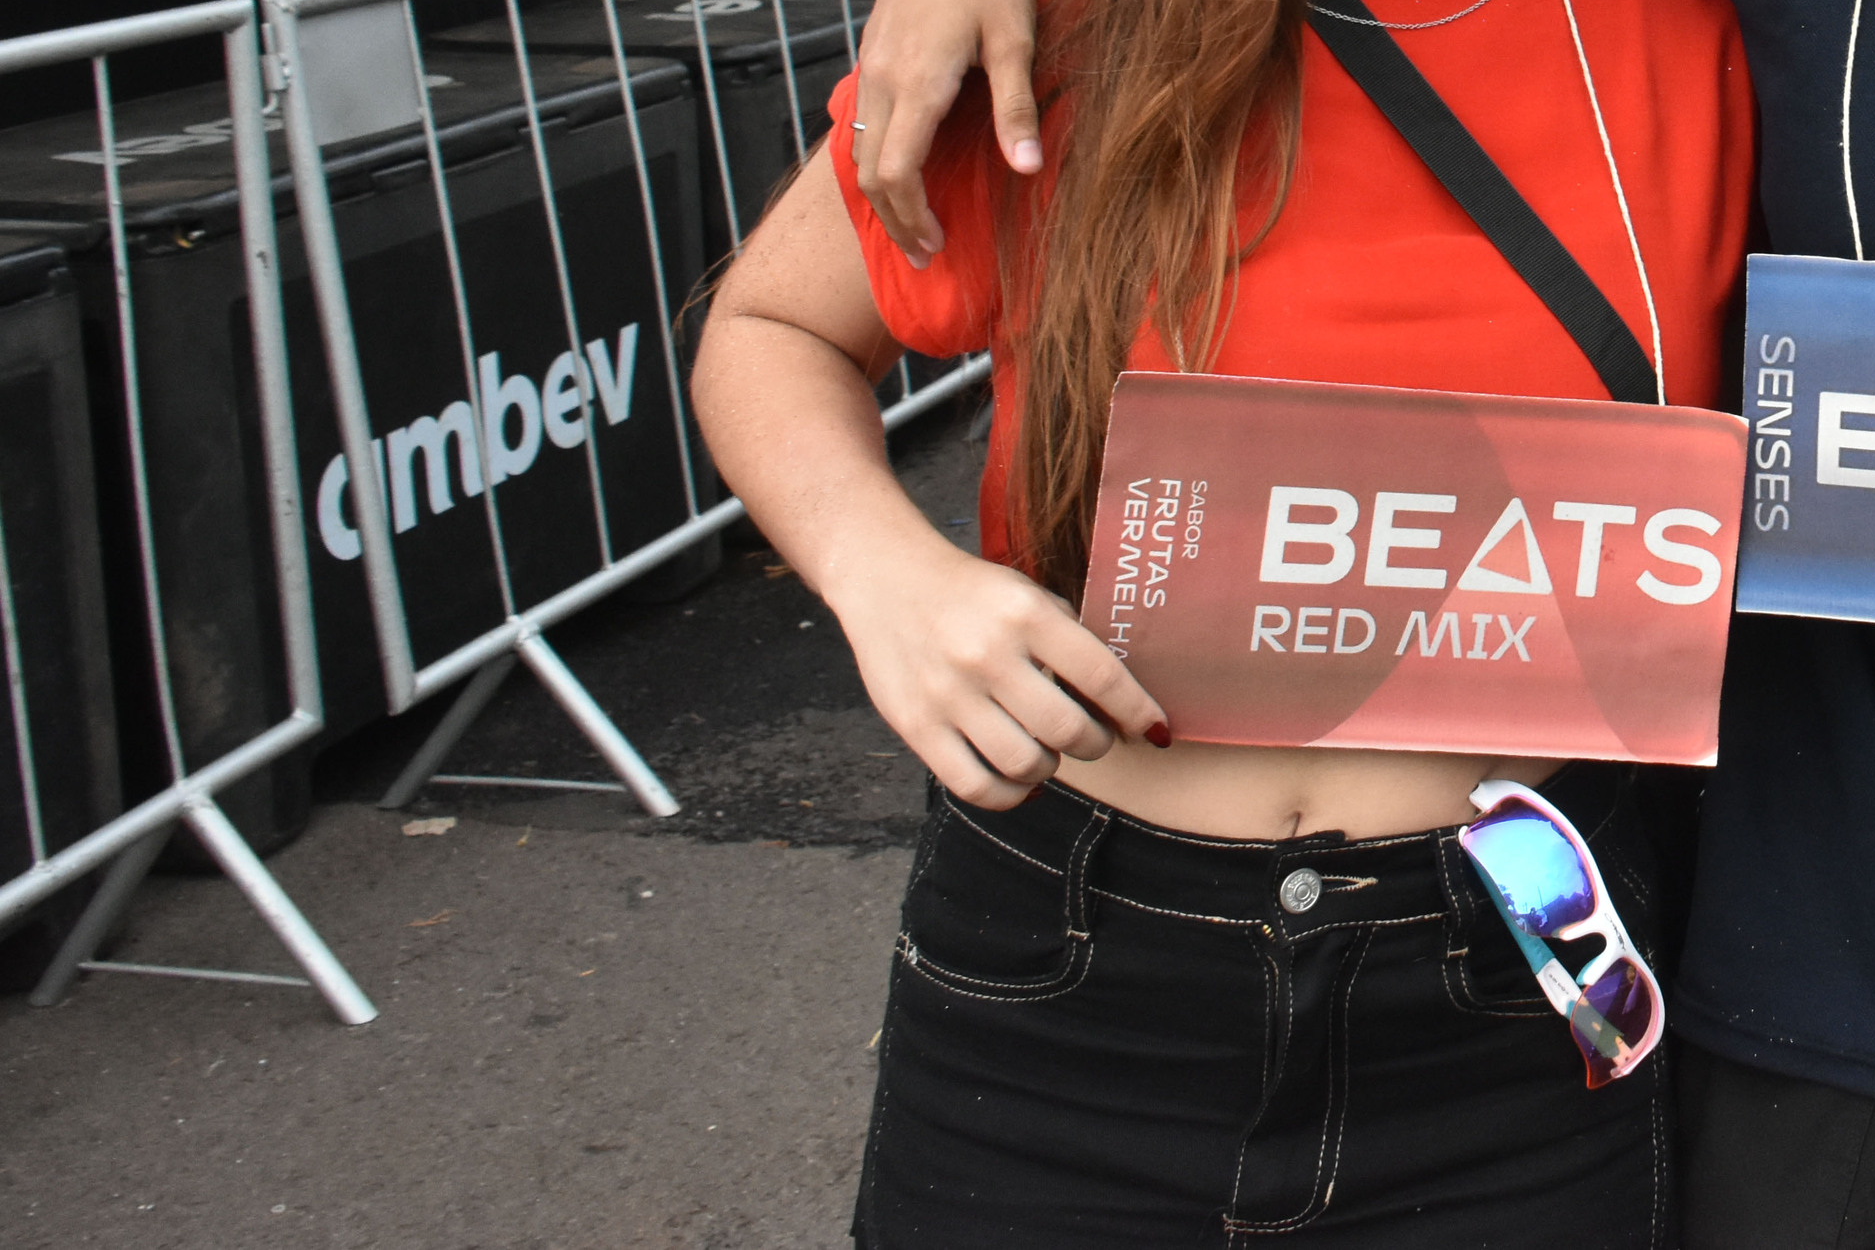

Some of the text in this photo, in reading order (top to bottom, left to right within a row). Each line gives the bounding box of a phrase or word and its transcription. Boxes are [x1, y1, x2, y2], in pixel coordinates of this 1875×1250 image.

[317, 323, 638, 561] ambev
[1754, 333, 1796, 532] SENSES
[1108, 477, 1152, 660] VERMELHA
[1143, 478, 1182, 608] FRUTAS
[1182, 480, 1208, 559] SABOR
[1259, 486, 1722, 605] BEATS
[1249, 605, 1537, 662] RED MIX
